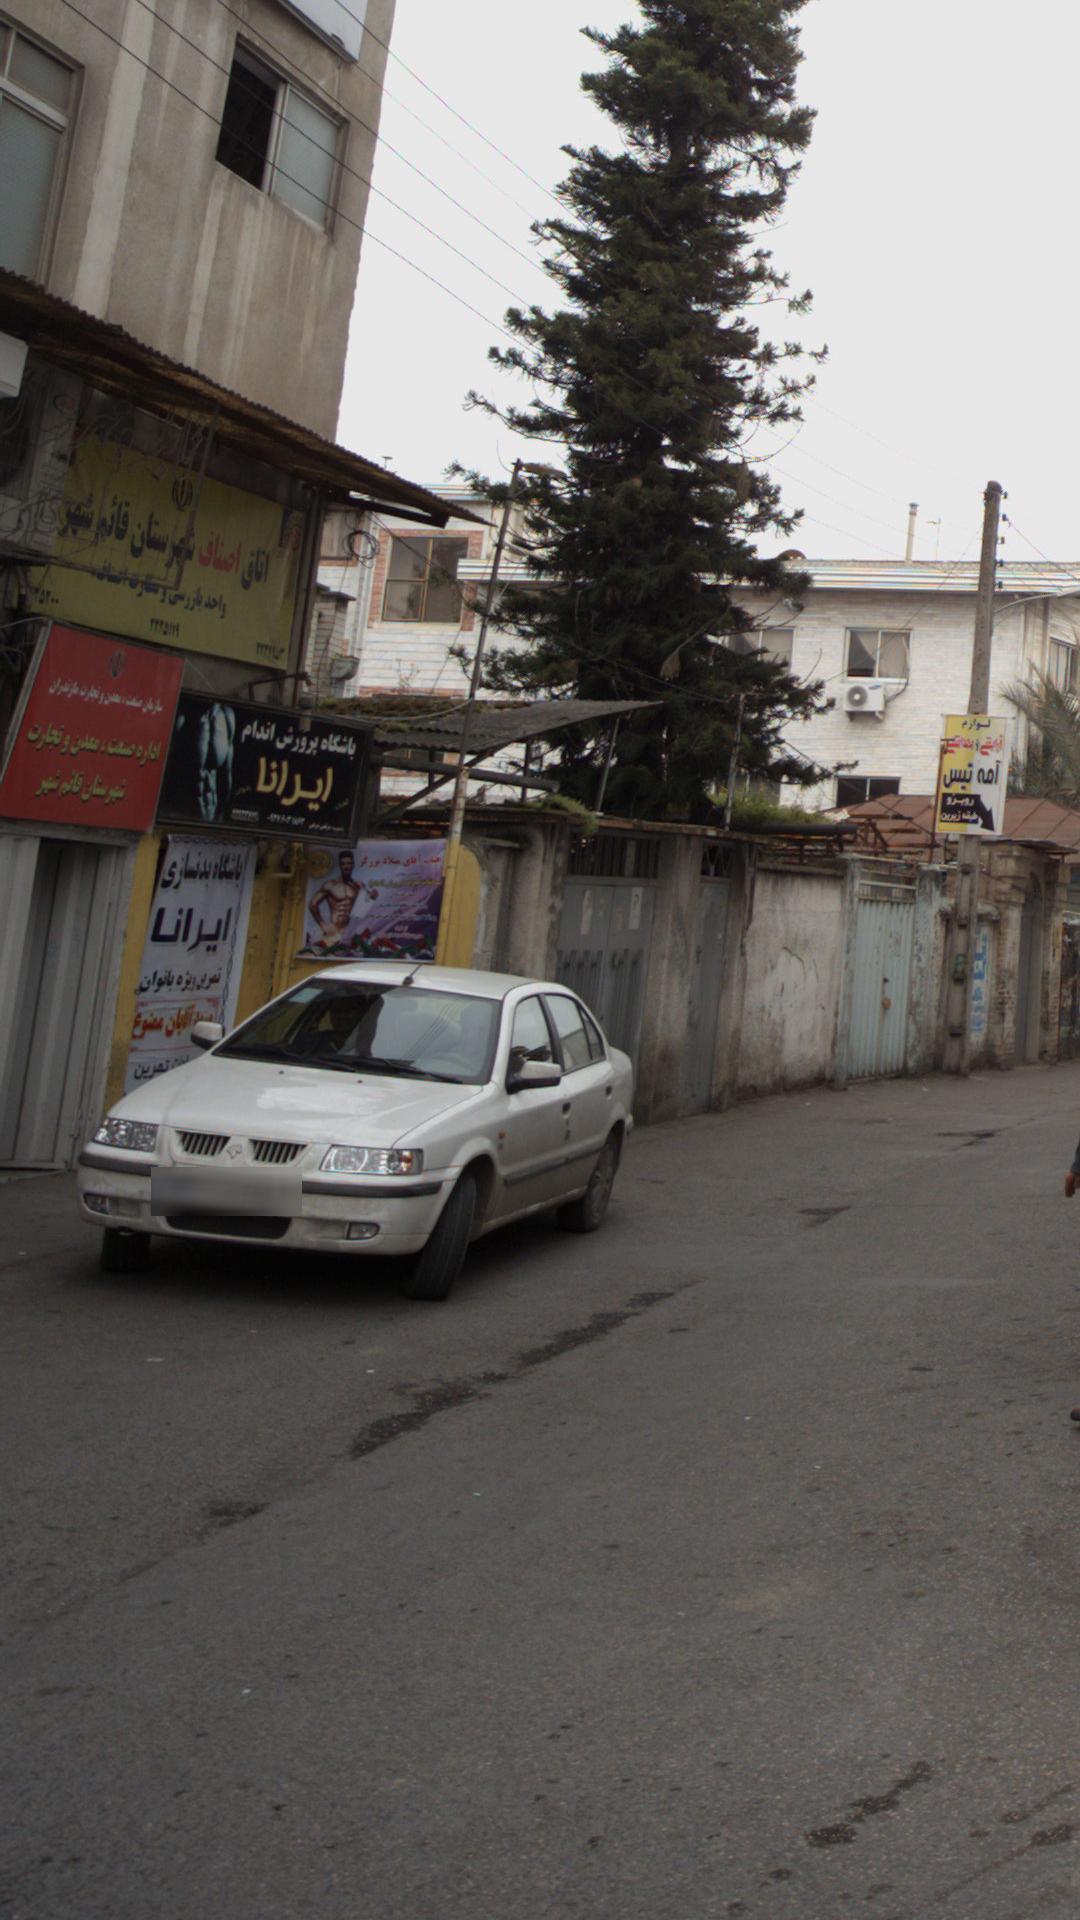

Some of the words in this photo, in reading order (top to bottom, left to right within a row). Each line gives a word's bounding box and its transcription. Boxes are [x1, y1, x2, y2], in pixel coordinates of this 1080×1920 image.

[198, 530, 242, 576] اصناف
[240, 546, 271, 590] اتاق
[27, 723, 65, 752] تجارت
[240, 719, 277, 743] اندام
[961, 719, 991, 731] لوازم
[70, 734, 99, 757] معدن
[135, 740, 162, 767] اداره
[275, 725, 320, 756] پرورش
[320, 733, 357, 760] باشگاه
[80, 774, 127, 805] شهرستان
[256, 755, 334, 812] ایرانا
[160, 851, 211, 889] بدنسازی
[212, 852, 242, 888] باشگاه
[151, 907, 232, 952] ایرانا
[138, 969, 175, 993] بانوان
[131, 1012, 164, 1039] ممنوع
[165, 1003, 196, 1037] آقایان
[134, 1060, 170, 1080] تمرین
